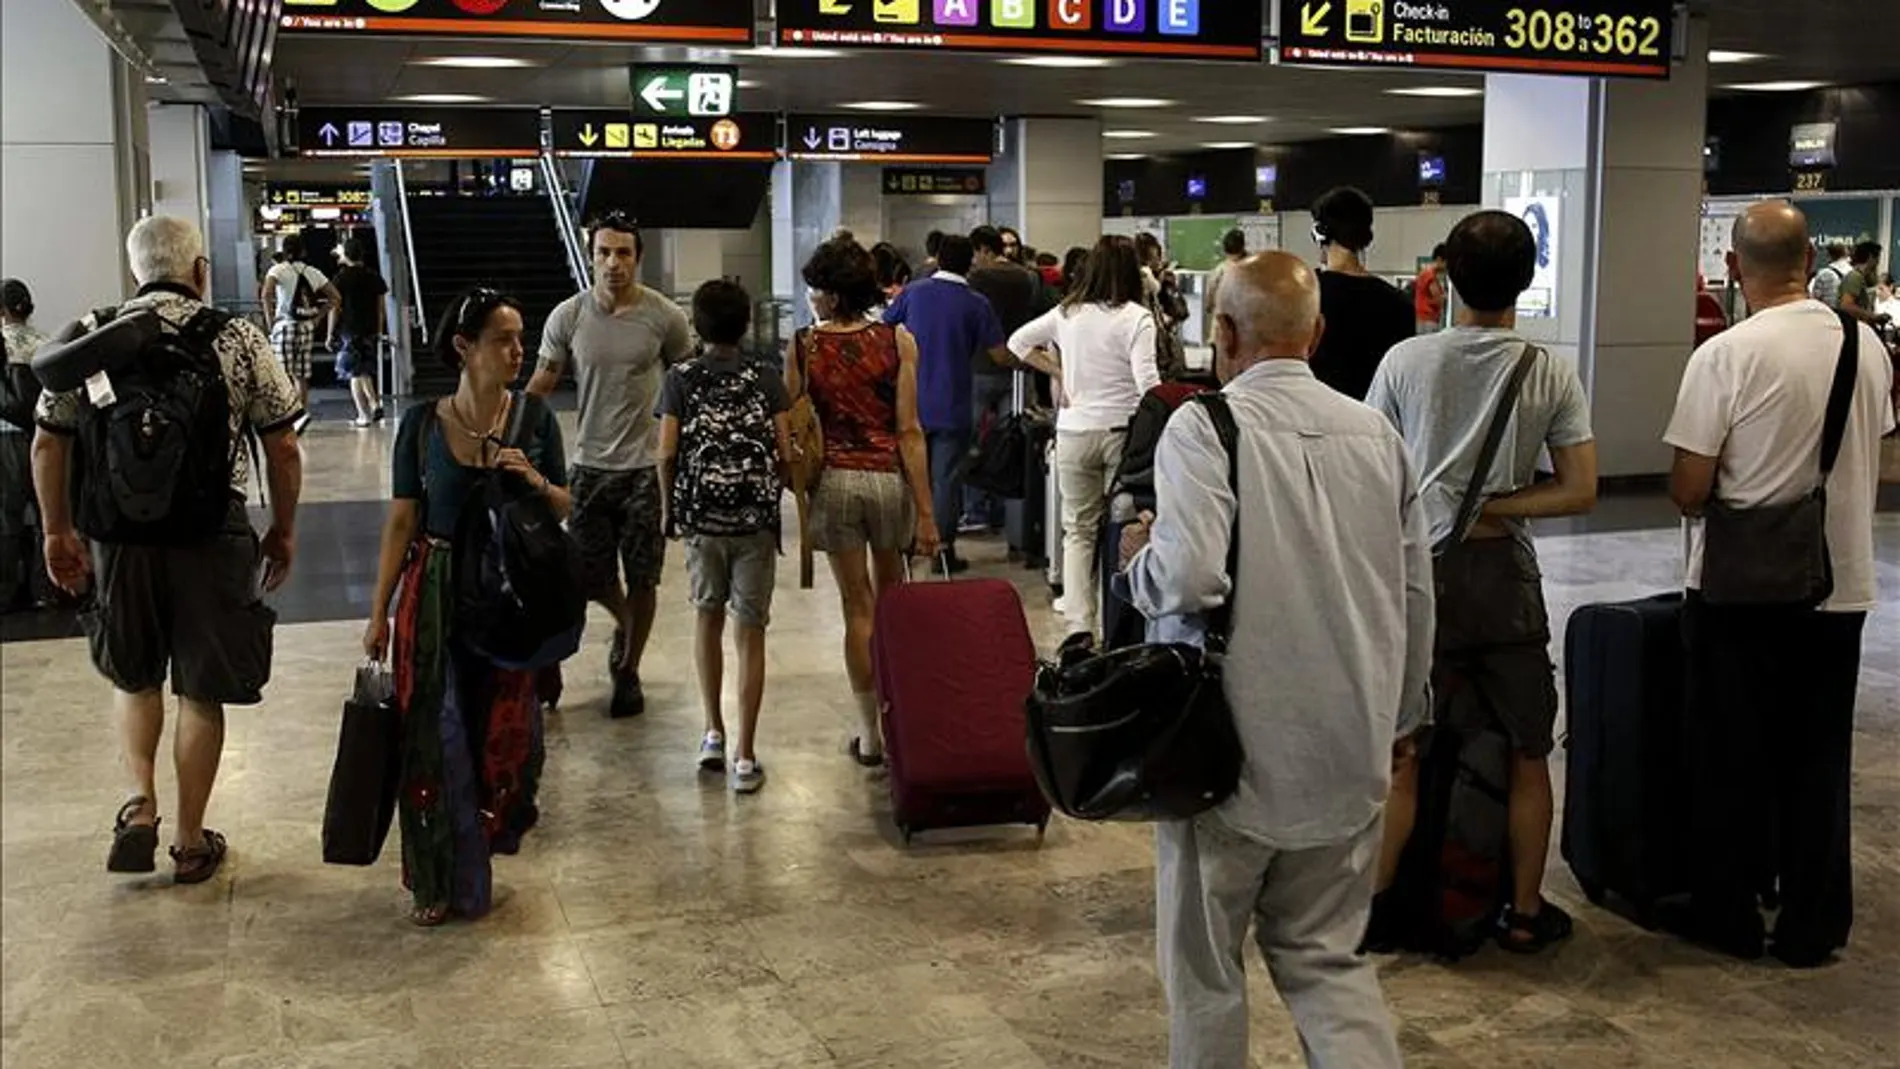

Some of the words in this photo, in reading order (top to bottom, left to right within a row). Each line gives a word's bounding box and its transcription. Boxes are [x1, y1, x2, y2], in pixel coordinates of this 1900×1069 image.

[943, 0, 969, 17] A
[1001, 0, 1024, 19] B
[1058, 0, 1082, 24] C
[1113, 0, 1137, 24] D
[1169, 0, 1189, 27] E
[1393, 2, 1450, 20] Check-in
[1504, 8, 1576, 50] 308
[1578, 14, 1592, 30] to
[1393, 23, 1495, 47] Facturación
[1592, 14, 1660, 56] 362
[1578, 37, 1589, 52] a
[408, 123, 440, 134] Chapel
[408, 135, 446, 147] Capilla
[1797, 172, 1822, 189] 237
